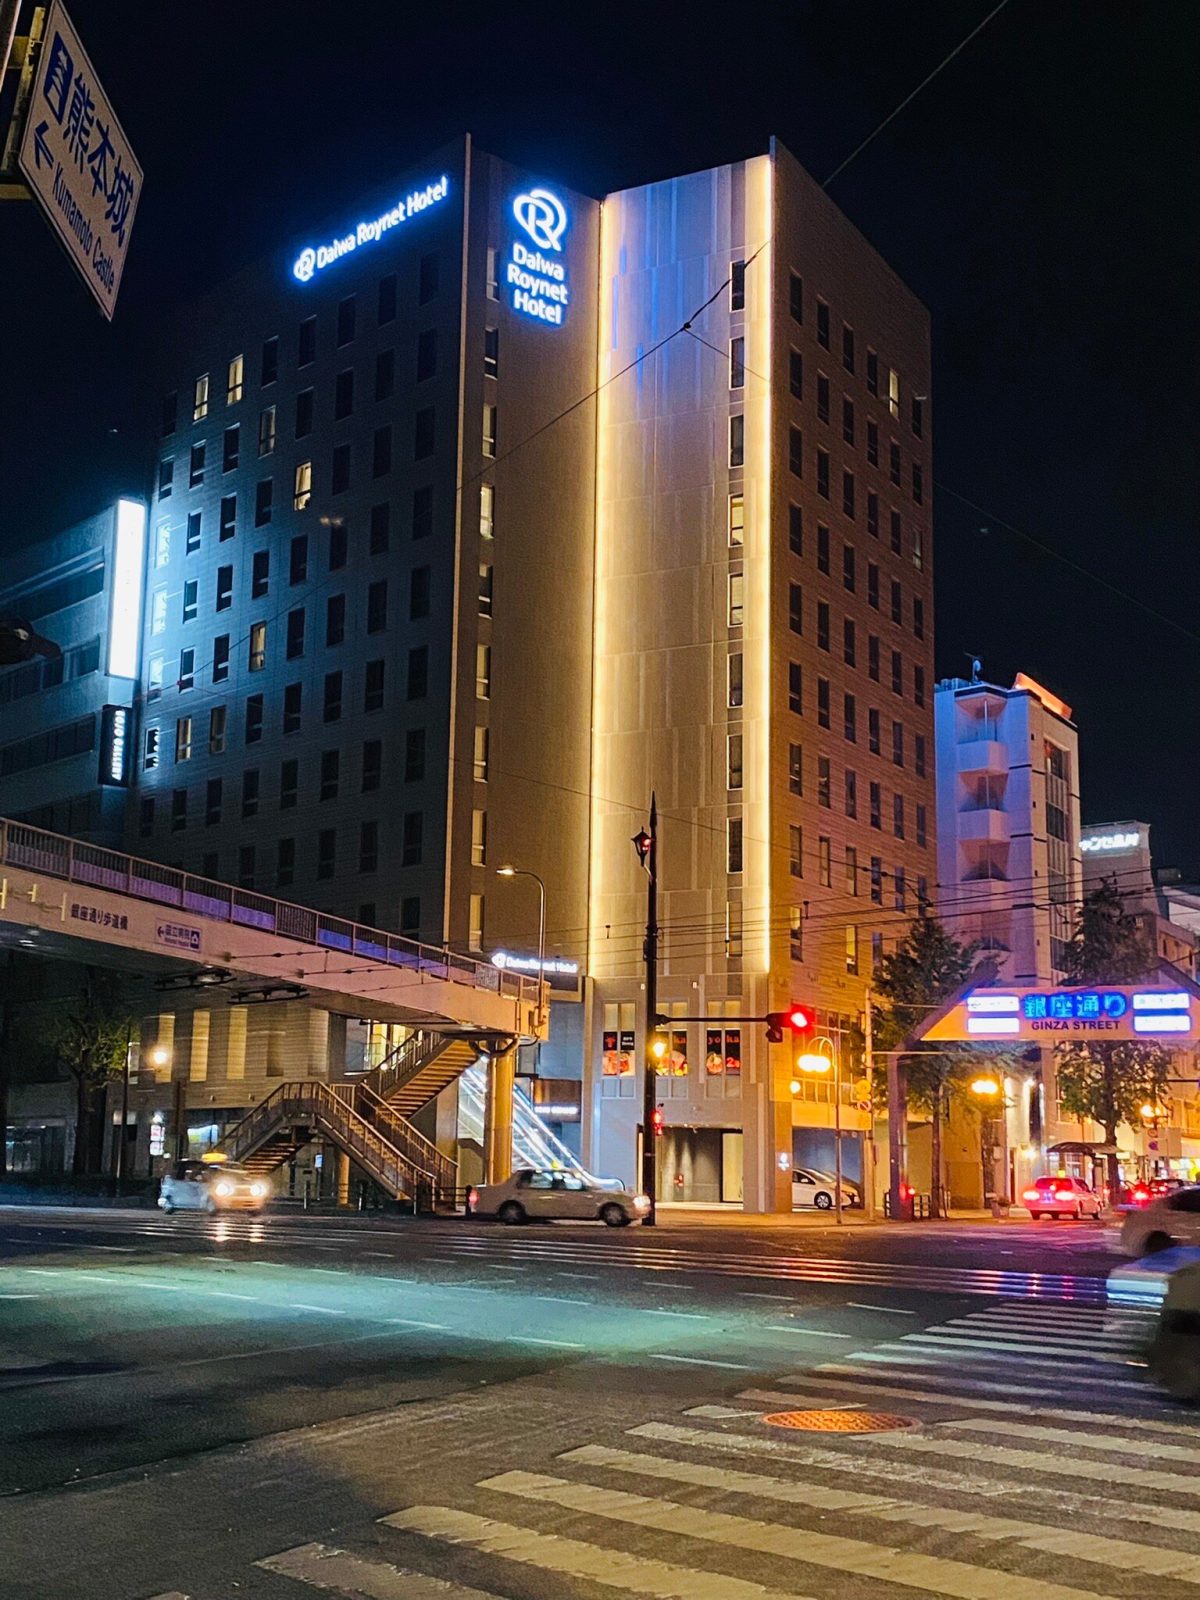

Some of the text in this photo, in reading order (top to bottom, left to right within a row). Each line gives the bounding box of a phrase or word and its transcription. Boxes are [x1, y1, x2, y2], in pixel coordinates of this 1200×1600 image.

[63, 72, 134, 248] 熊本城
[52, 162, 115, 295] Kumamoto Castle
[317, 233, 356, 269] Daiwa
[356, 203, 406, 245] Roynet
[406, 175, 448, 217] Hotel
[513, 243, 564, 281] Daiwa
[507, 264, 568, 305] Roynet
[513, 289, 562, 325] Hotel
[1025, 995, 1126, 1018] 銀座通り
[1031, 1020, 1121, 1031] GINZA STREET
